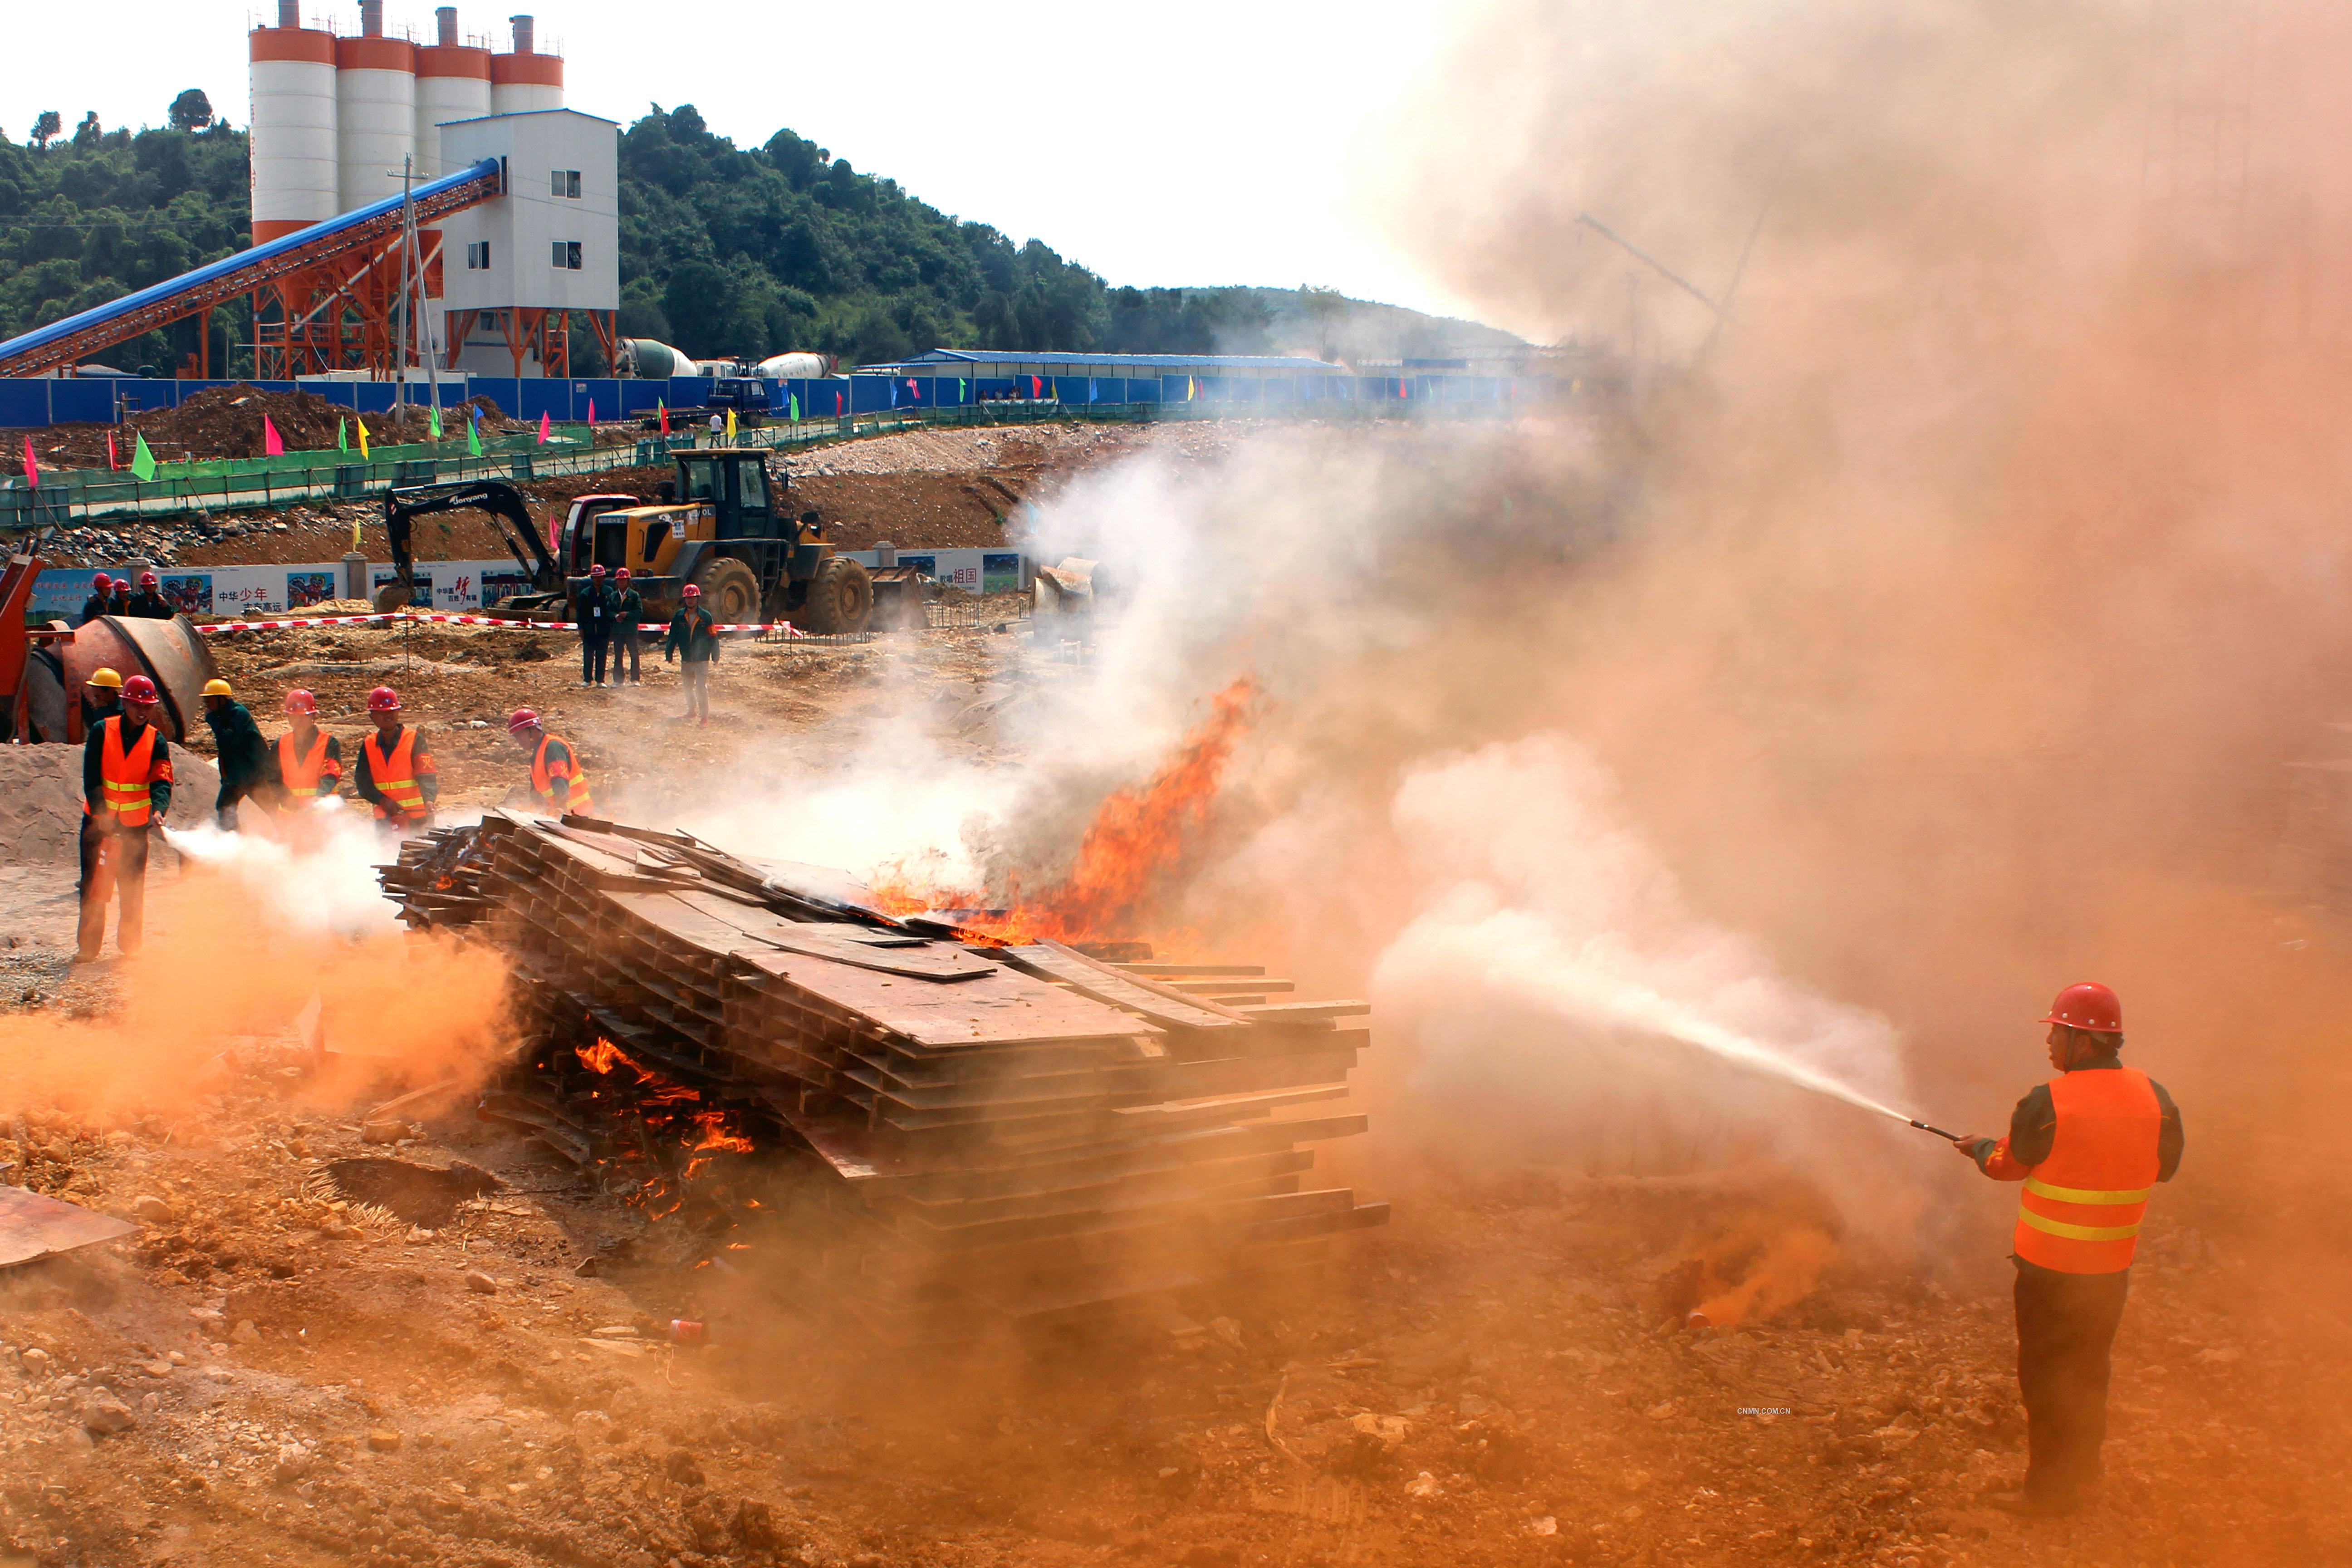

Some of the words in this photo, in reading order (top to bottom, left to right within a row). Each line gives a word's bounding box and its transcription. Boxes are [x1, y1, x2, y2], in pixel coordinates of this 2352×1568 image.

[219, 587, 267, 602] 中华少年
[421, 755, 432, 769] 灭
